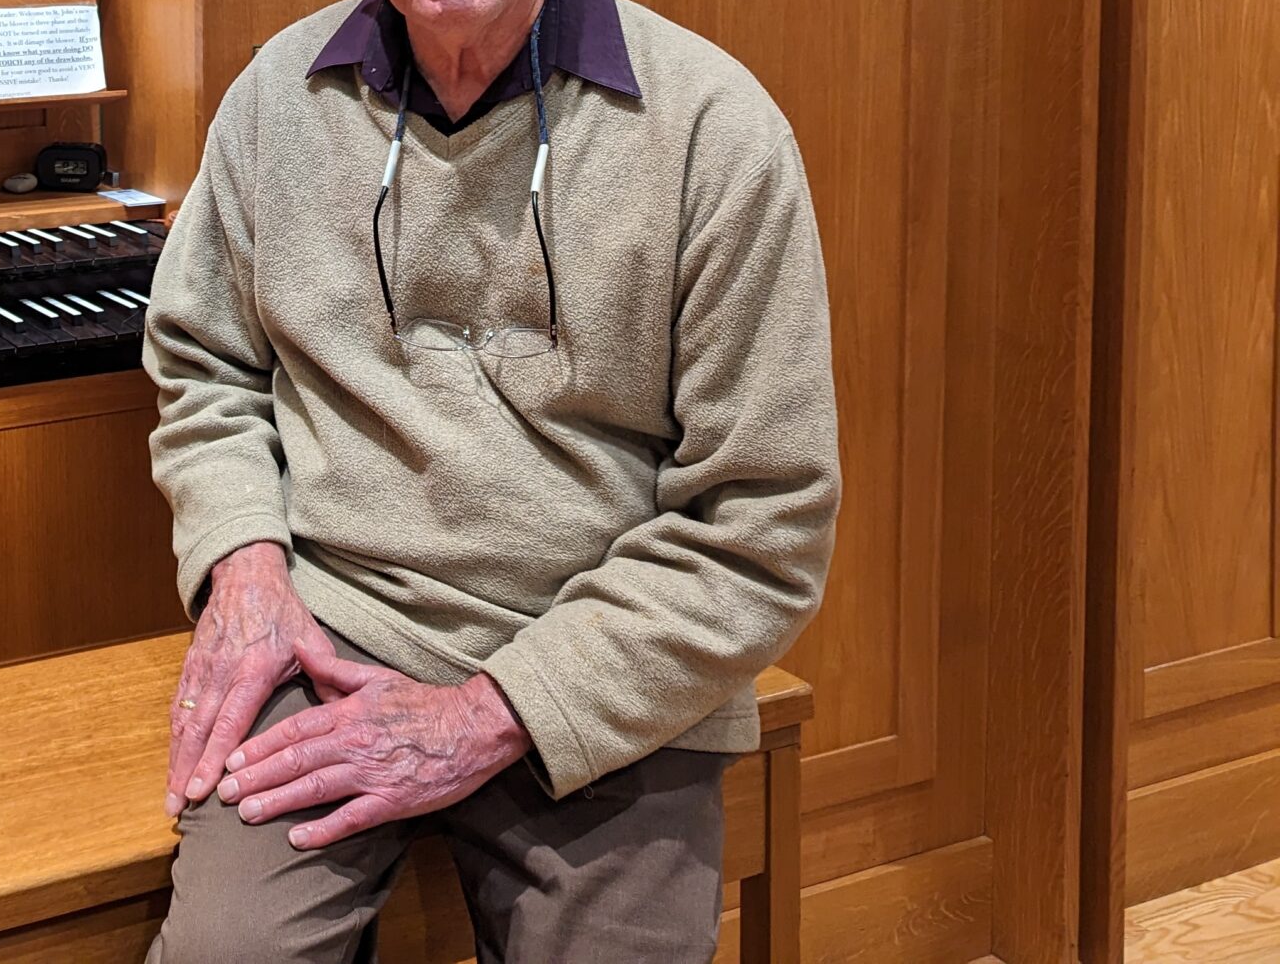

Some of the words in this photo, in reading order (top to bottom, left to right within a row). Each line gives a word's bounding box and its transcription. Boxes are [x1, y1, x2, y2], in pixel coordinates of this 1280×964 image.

[61, 8, 78, 16] John's
[59, 27, 90, 35] immediately
[25, 39, 44, 47] damage
[63, 46, 81, 54] doing
[24, 59, 35, 67] any
[37, 57, 44, 65] of
[56, 55, 93, 64] drawknobs.
[10, 70, 23, 78] your
[38, 67, 51, 76] good
[48, 75, 69, 83] Thanks!
